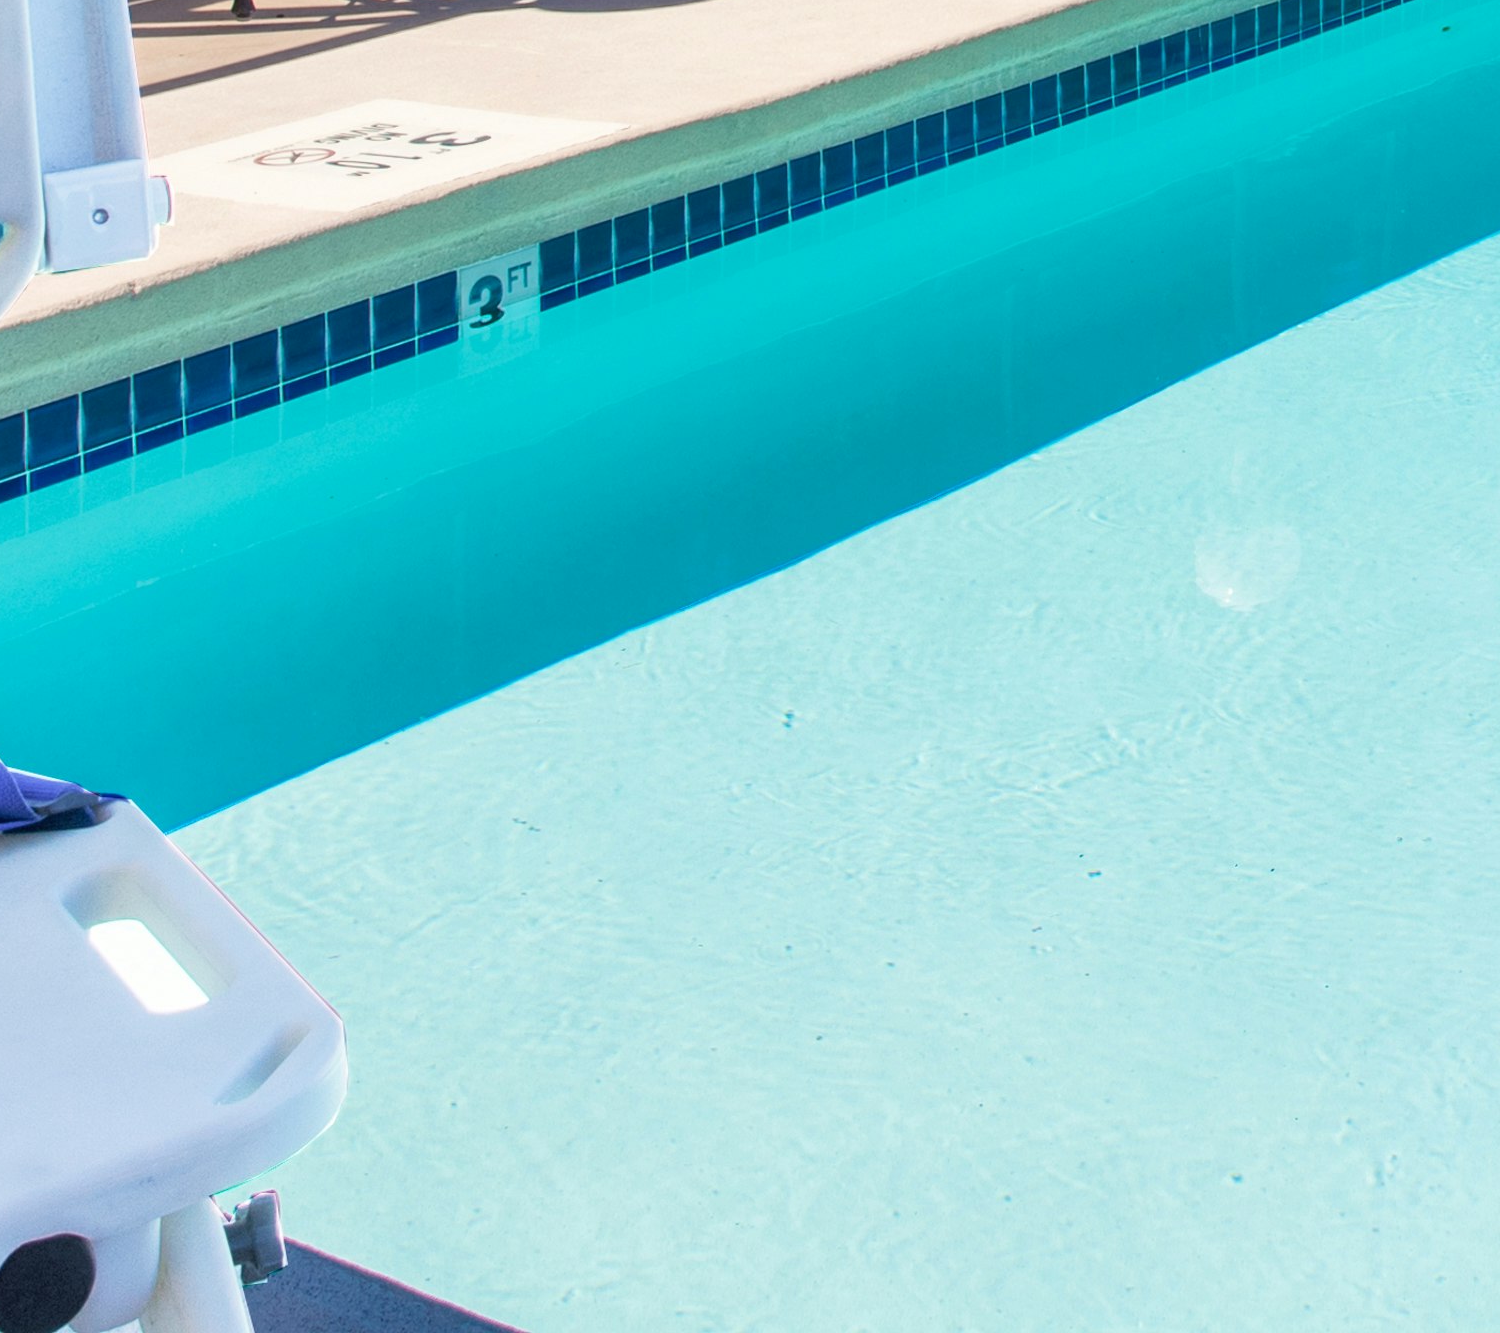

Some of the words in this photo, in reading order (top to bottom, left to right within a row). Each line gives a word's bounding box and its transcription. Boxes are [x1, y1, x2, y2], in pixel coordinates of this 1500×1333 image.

[313, 122, 400, 145] DIVING
[365, 132, 408, 142] NO
[409, 131, 492, 147] 3
[468, 275, 504, 329] 3
[507, 261, 532, 293] FT
